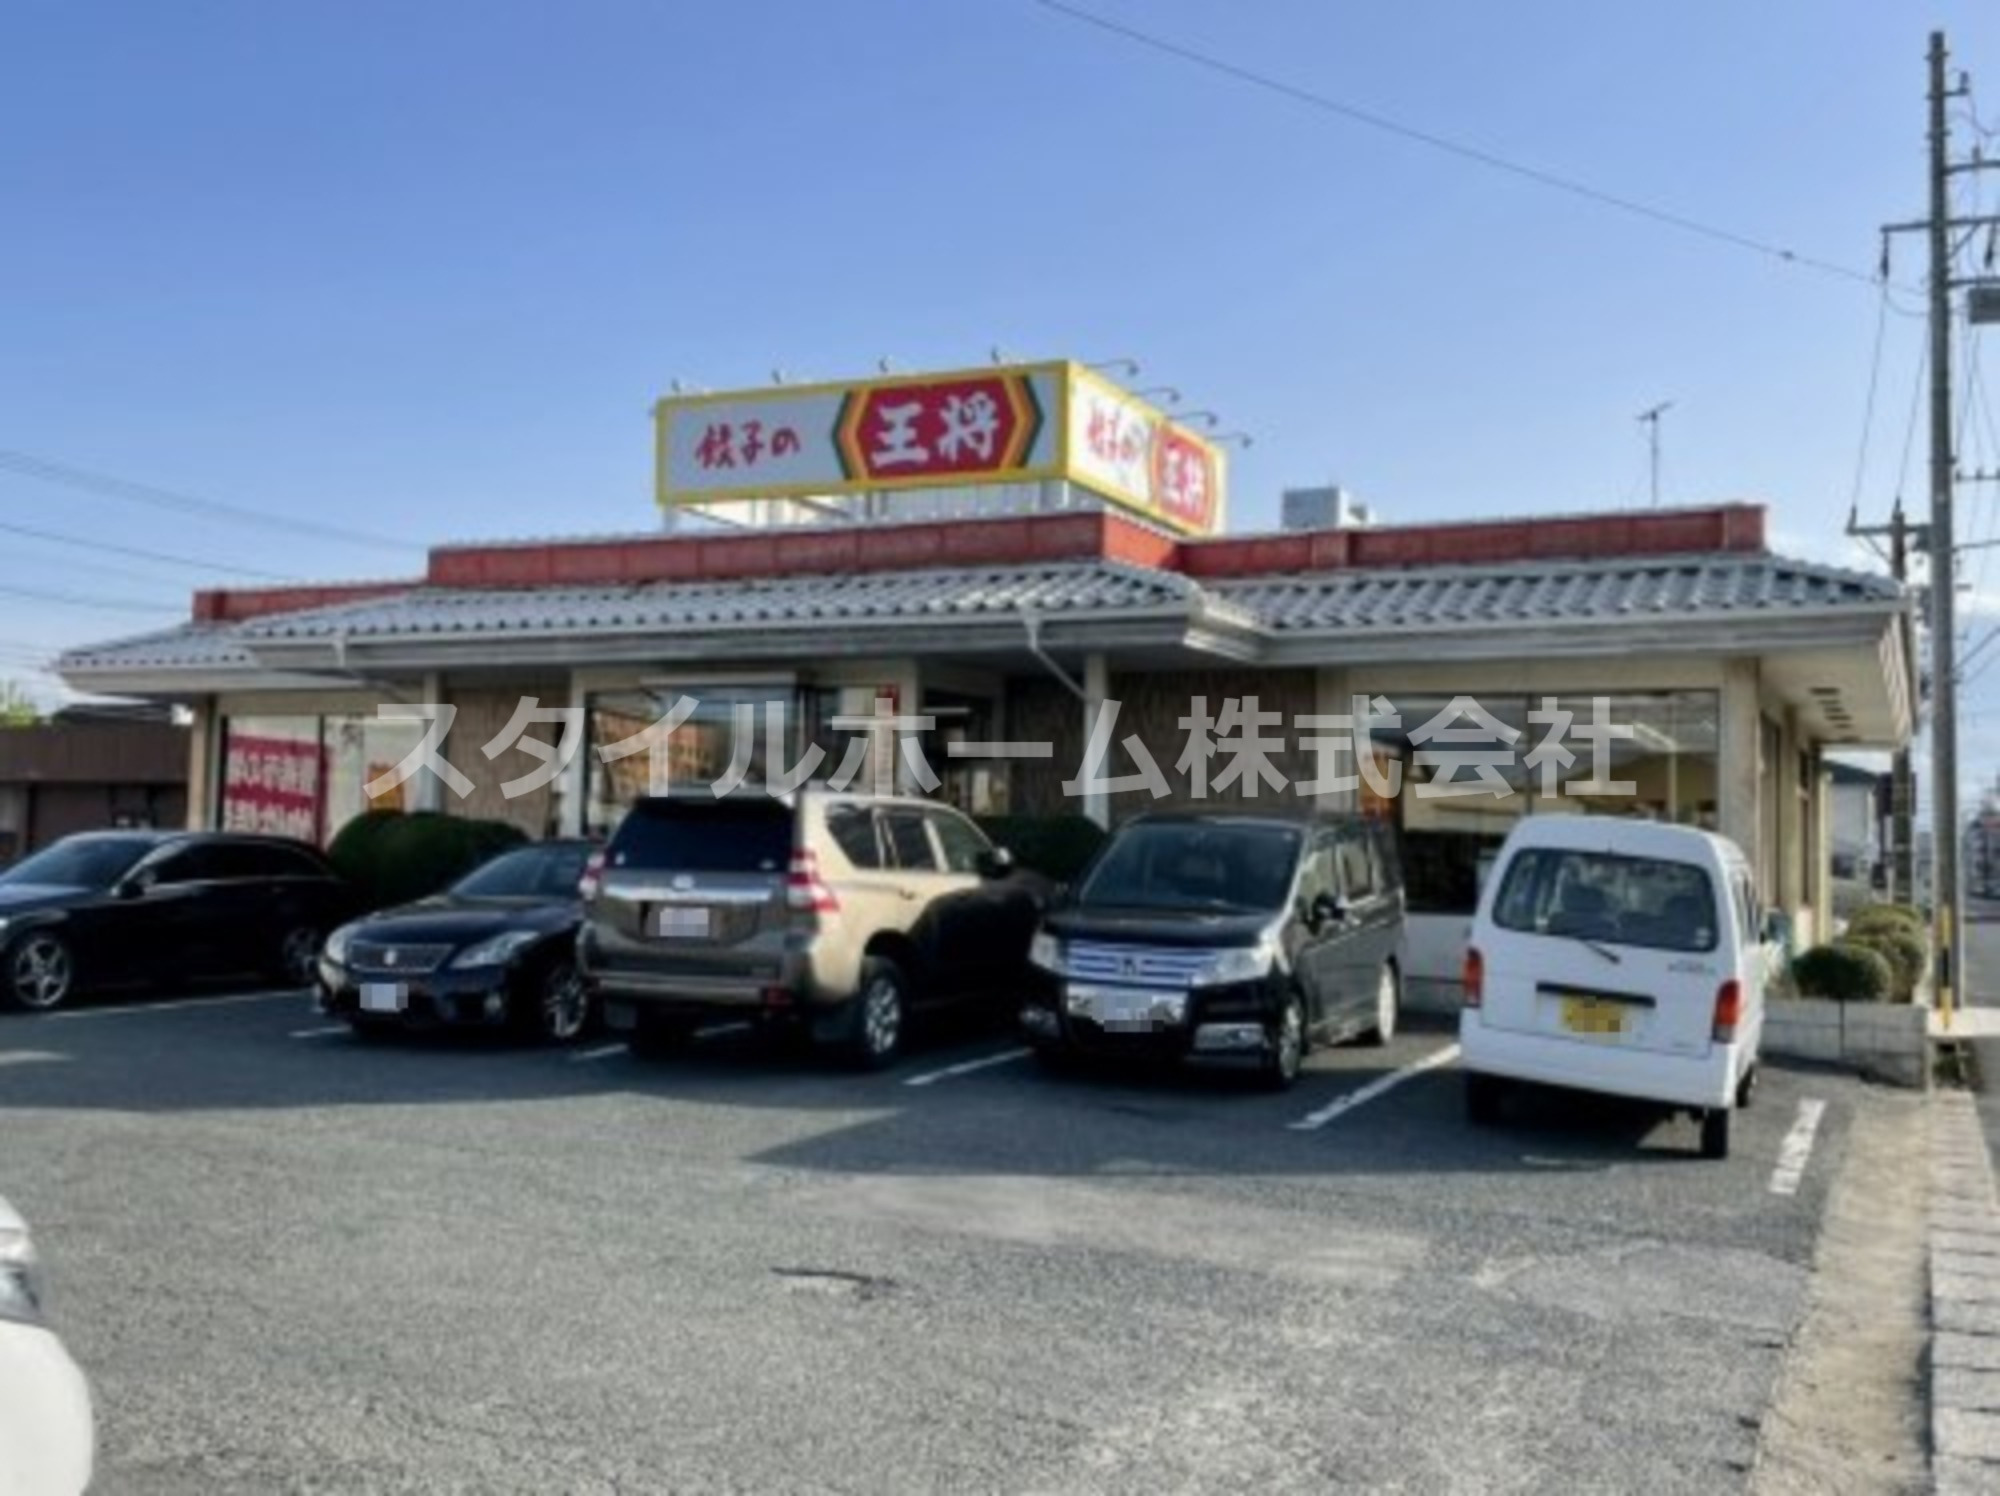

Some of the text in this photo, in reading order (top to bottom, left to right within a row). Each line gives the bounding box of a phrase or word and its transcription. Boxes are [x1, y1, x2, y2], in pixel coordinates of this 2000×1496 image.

[694, 390, 1000, 470] 餃子の 王将
